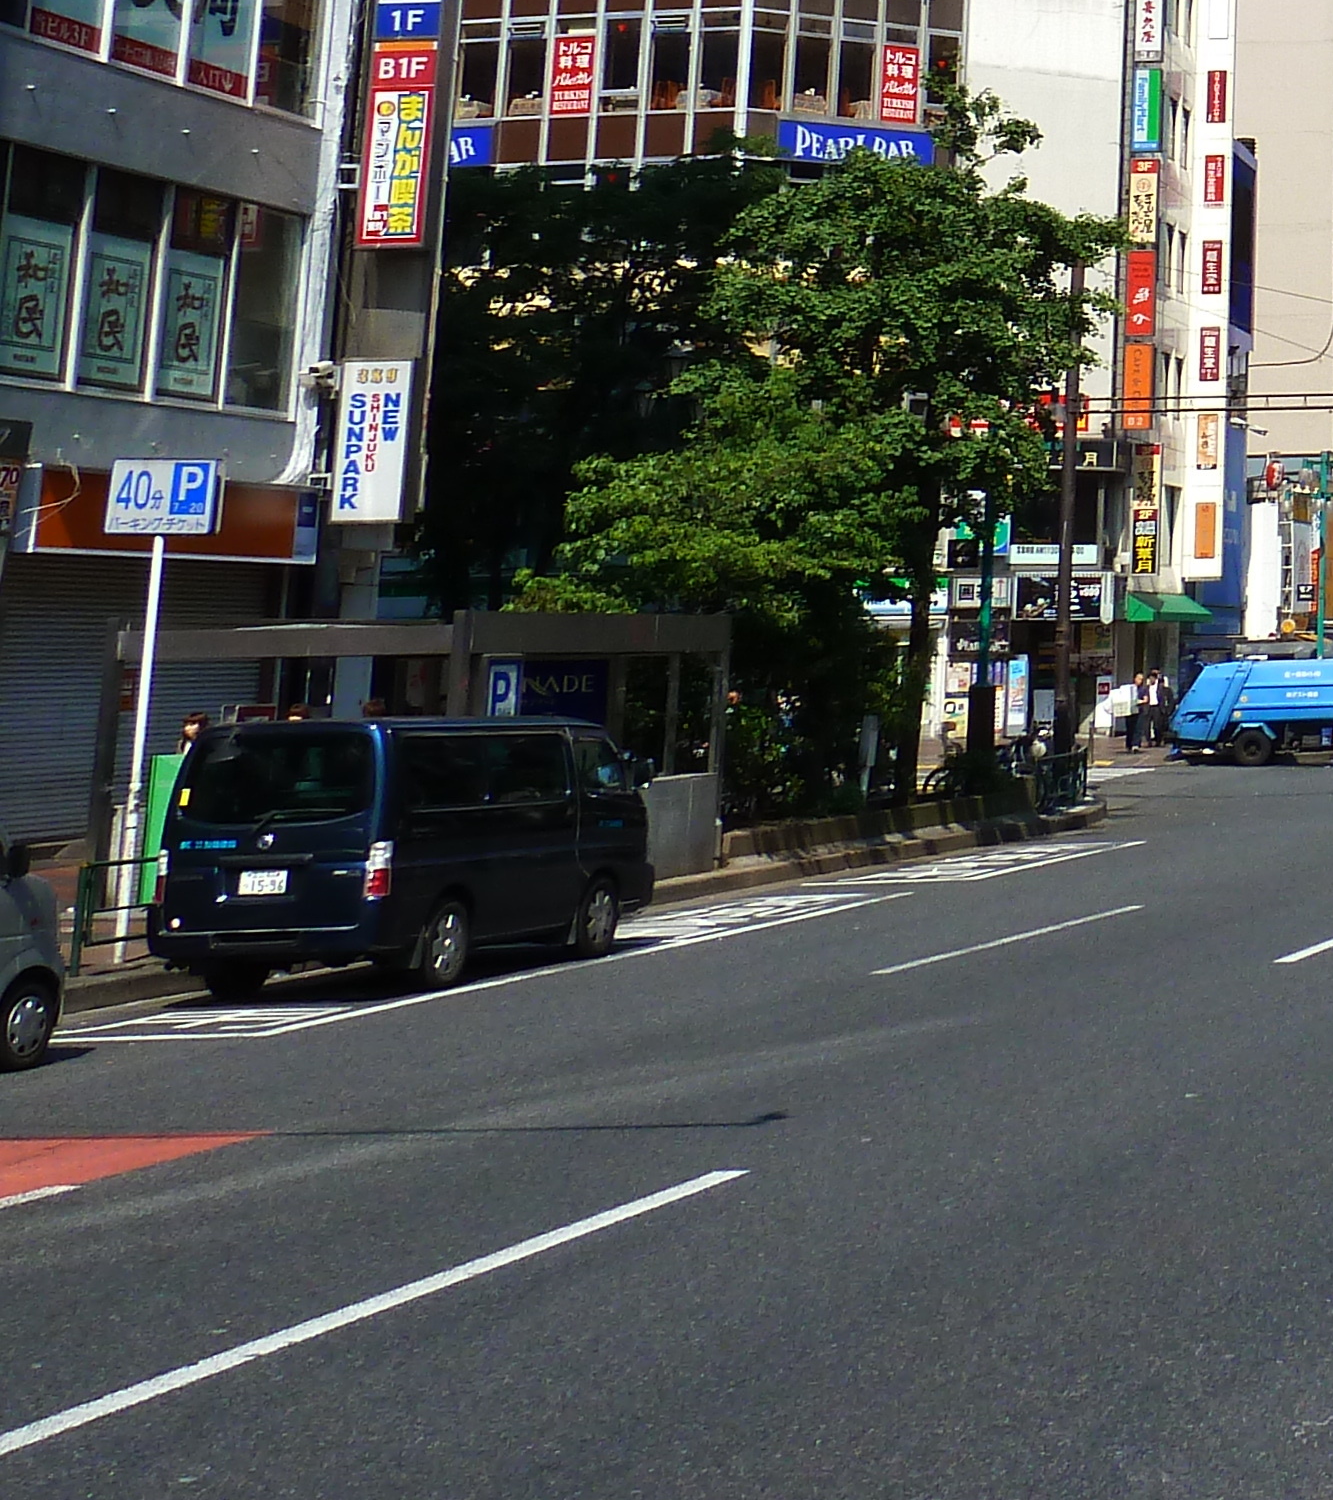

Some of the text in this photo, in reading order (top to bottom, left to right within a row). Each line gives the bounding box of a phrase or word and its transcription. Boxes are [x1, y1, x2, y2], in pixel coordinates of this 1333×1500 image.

[391, 10, 425, 31] 1F
[560, 41, 592, 55] トルコ
[886, 50, 917, 65] トルコ
[379, 57, 429, 79] B1F
[555, 55, 591, 69] 料理
[886, 65, 915, 79] 料理
[555, 90, 590, 100] TURKISH
[883, 98, 915, 109] TURKISH
[1136, 77, 1147, 132] FamilyMart
[388, 94, 424, 233] まんが喫茶
[381, 392, 402, 442] NEW
[365, 393, 381, 473] SHINJUKU
[339, 393, 367, 510] SUNPARK
[178, 466, 205, 501] P
